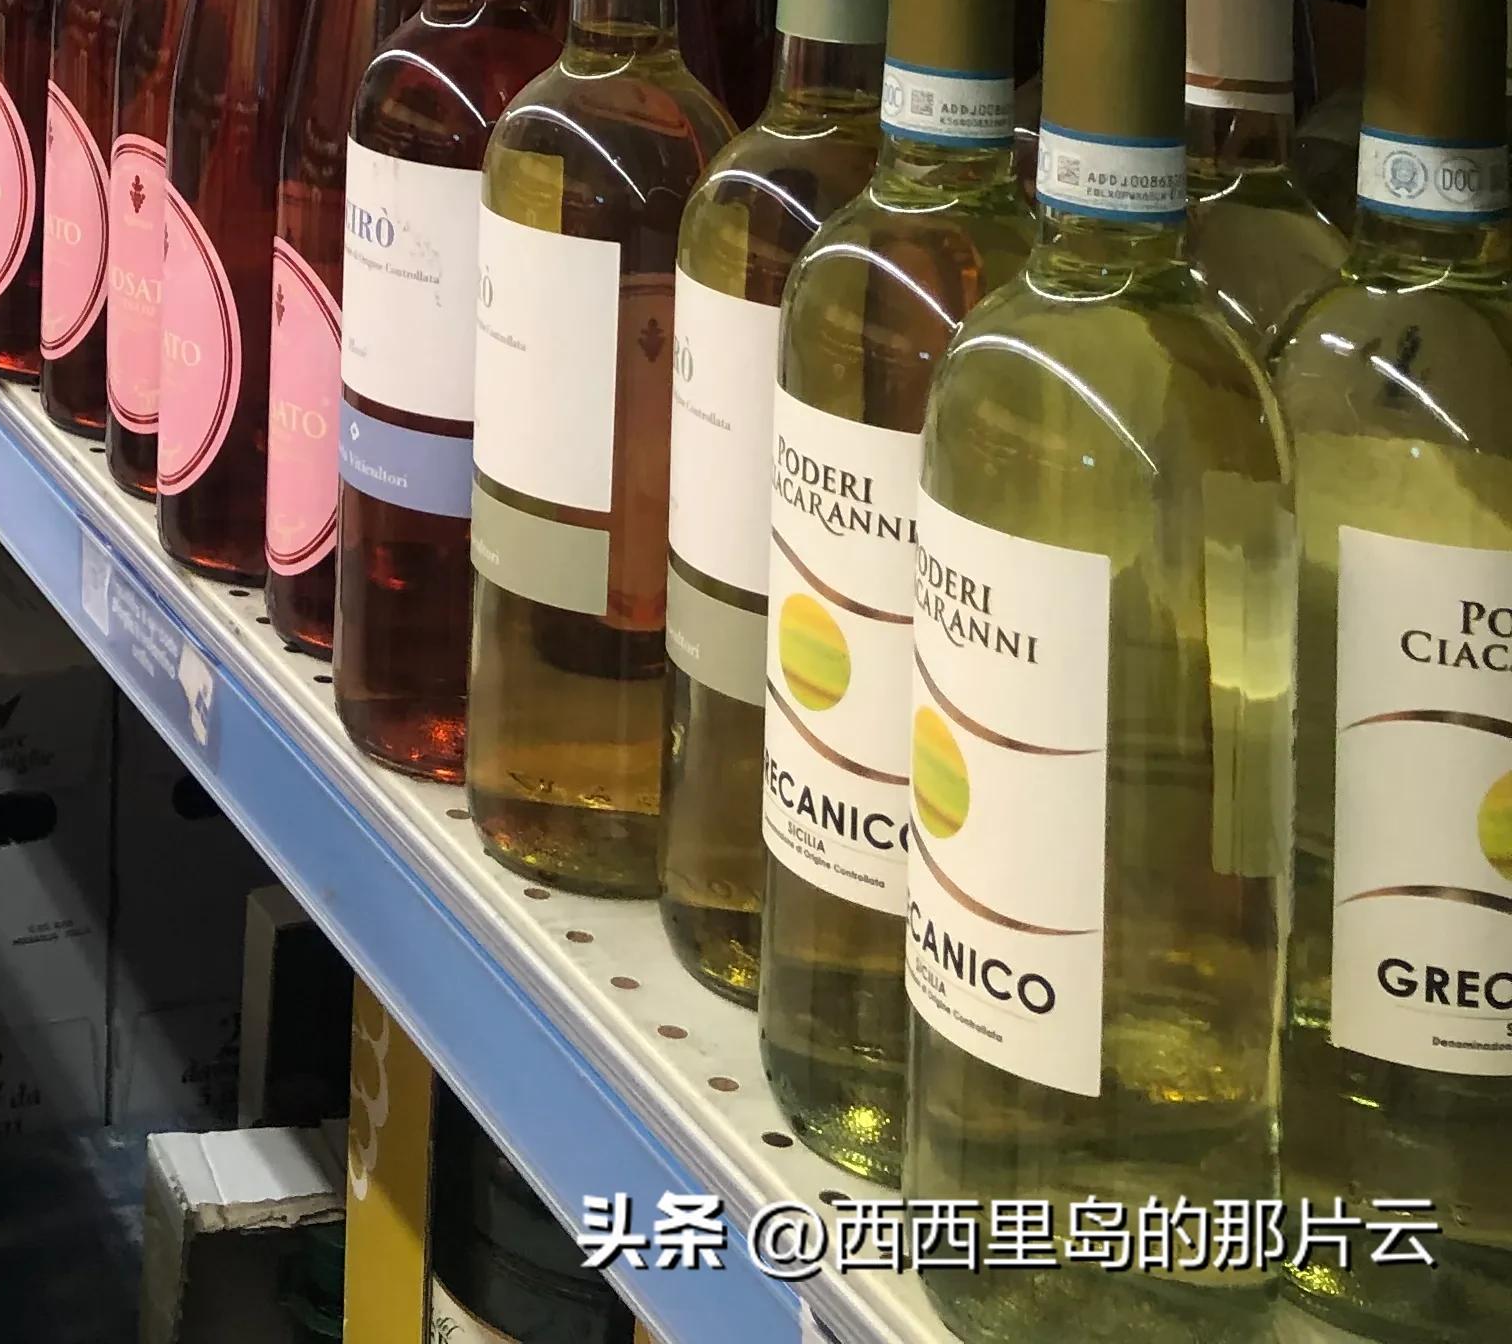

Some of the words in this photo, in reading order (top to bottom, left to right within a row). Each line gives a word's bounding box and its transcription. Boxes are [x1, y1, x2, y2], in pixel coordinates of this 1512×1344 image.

[386, 263, 441, 285] Controllata
[777, 434, 874, 505] PODERI
[787, 821, 826, 854] SICILIA
[833, 862, 886, 889] Controllata
[952, 1004, 1003, 1043] Controllata
